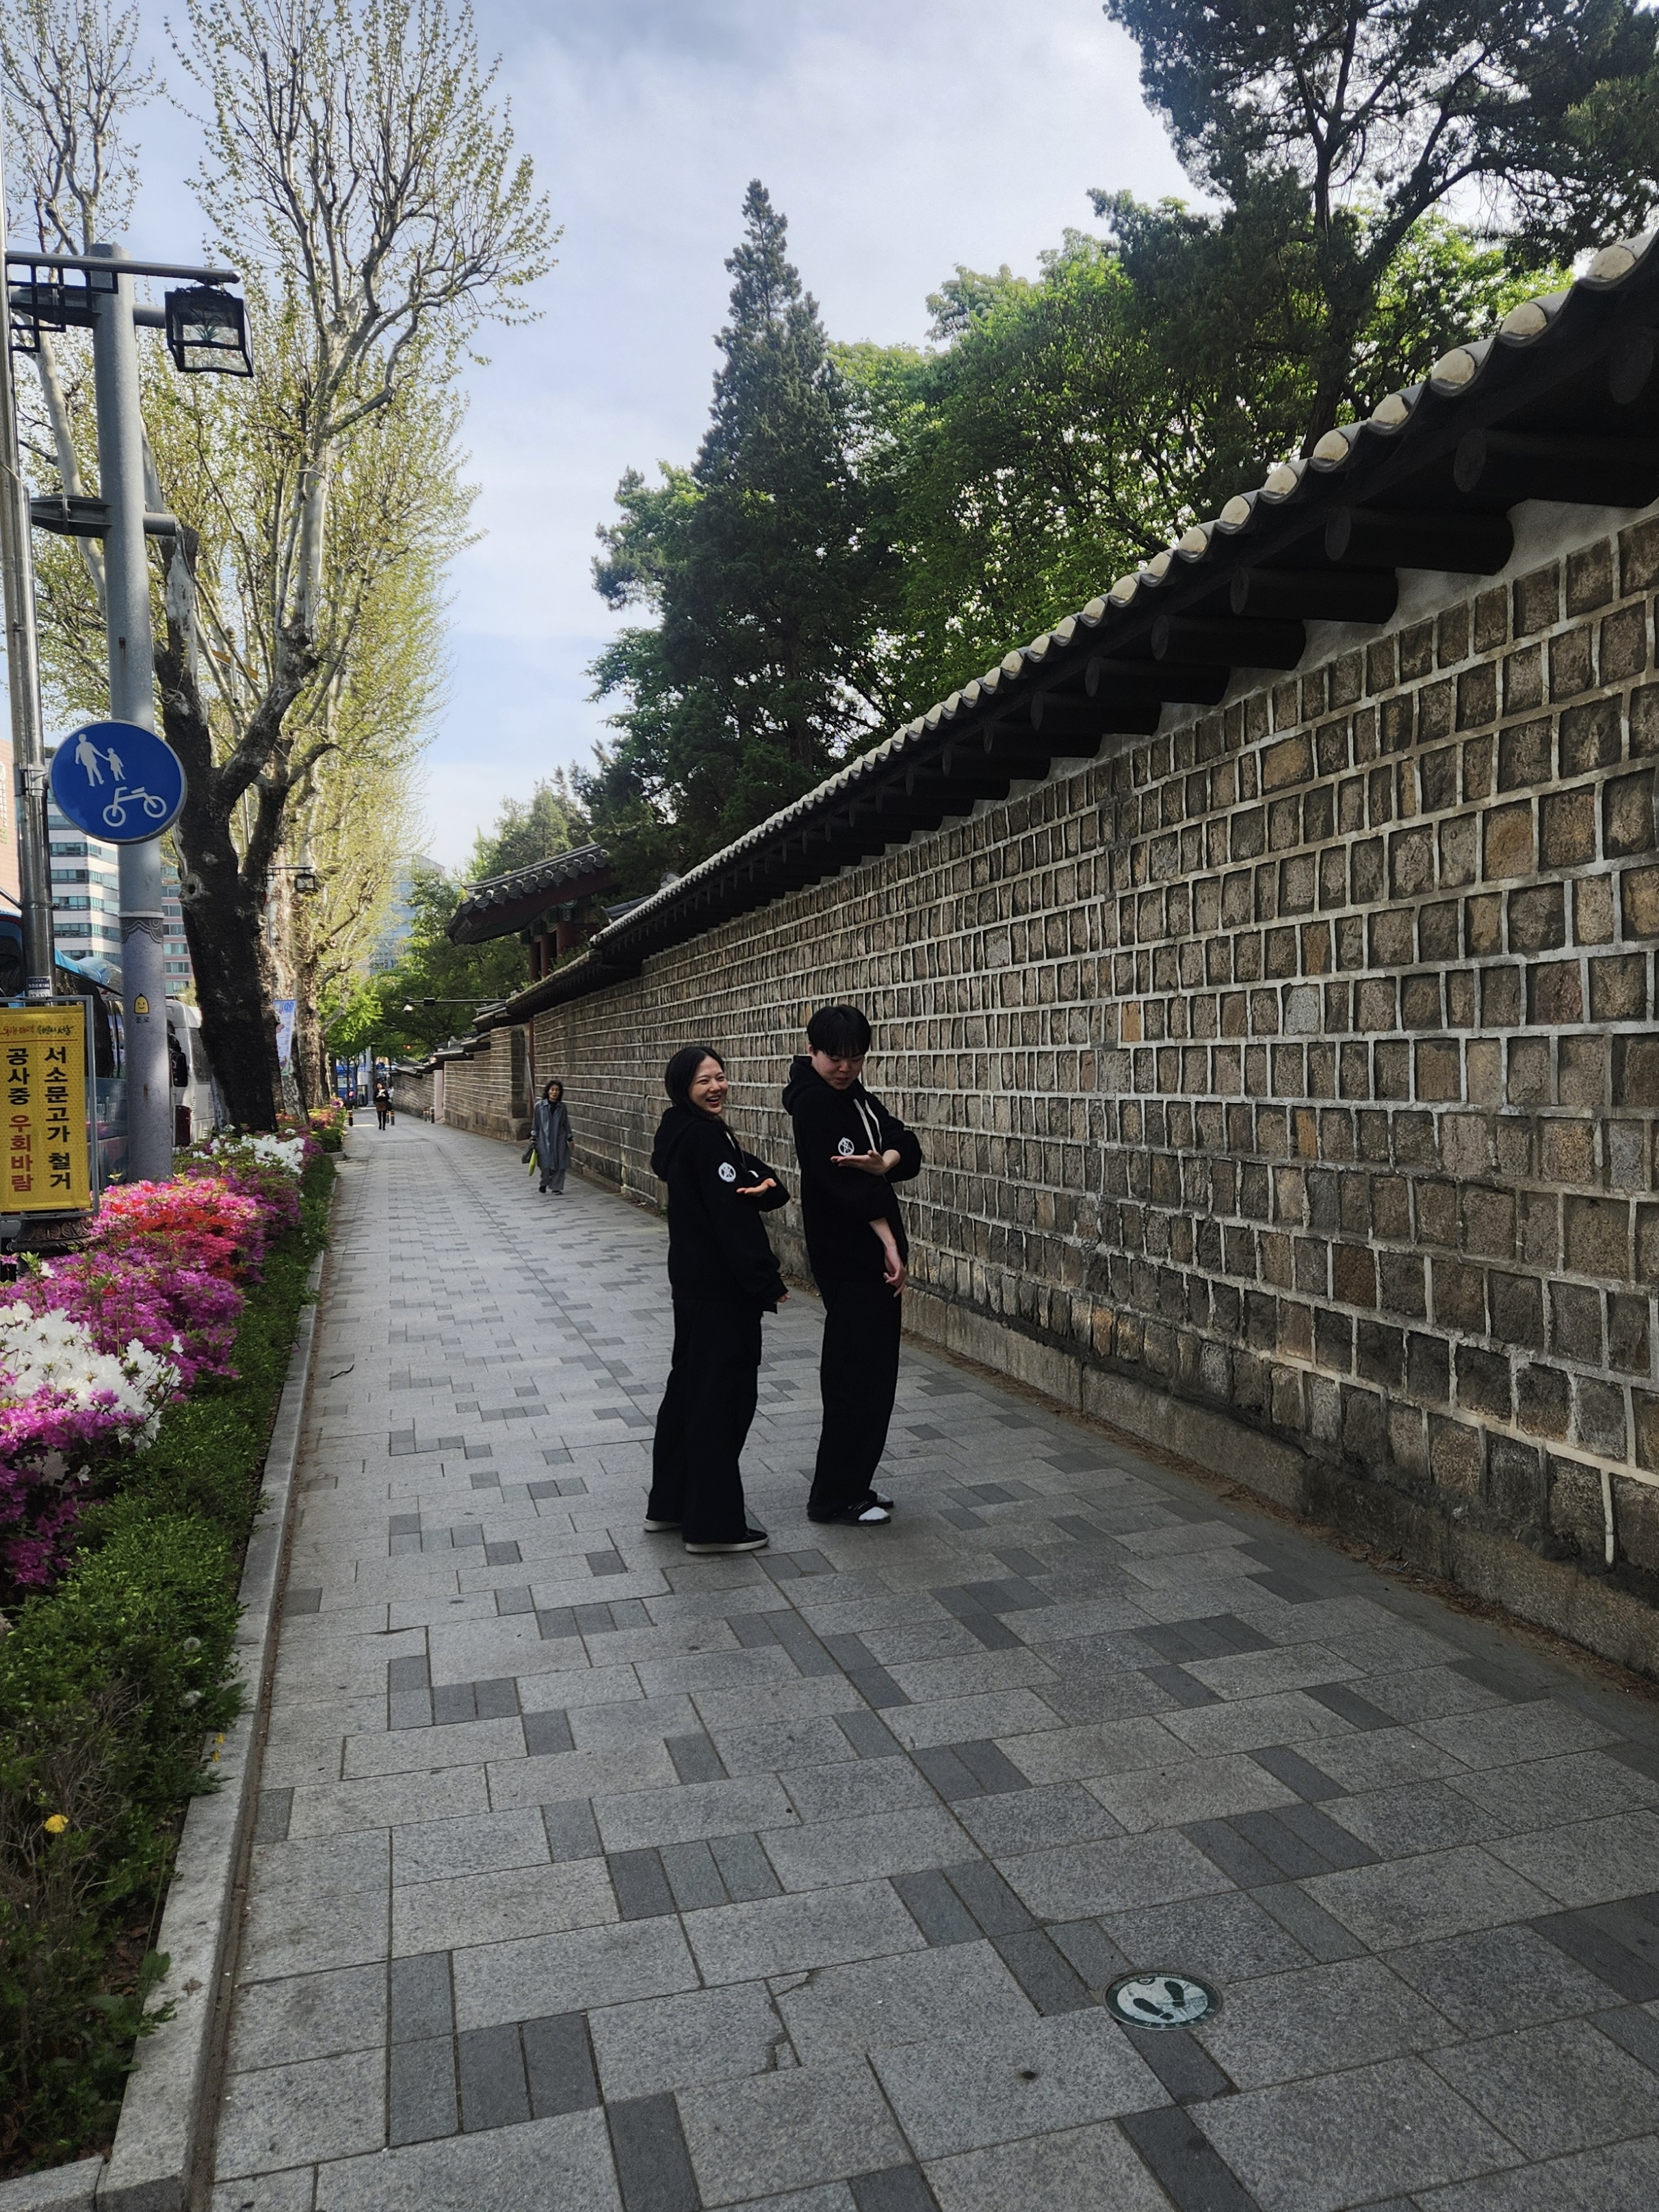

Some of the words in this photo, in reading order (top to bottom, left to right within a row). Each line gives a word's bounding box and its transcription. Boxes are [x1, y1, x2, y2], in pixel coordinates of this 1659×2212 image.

[6, 1048, 30, 1105] 공사중
[44, 1047, 70, 1143] 서소문고가
[9, 1115, 34, 1192] 우회바람
[49, 1152, 71, 1190] 철거
